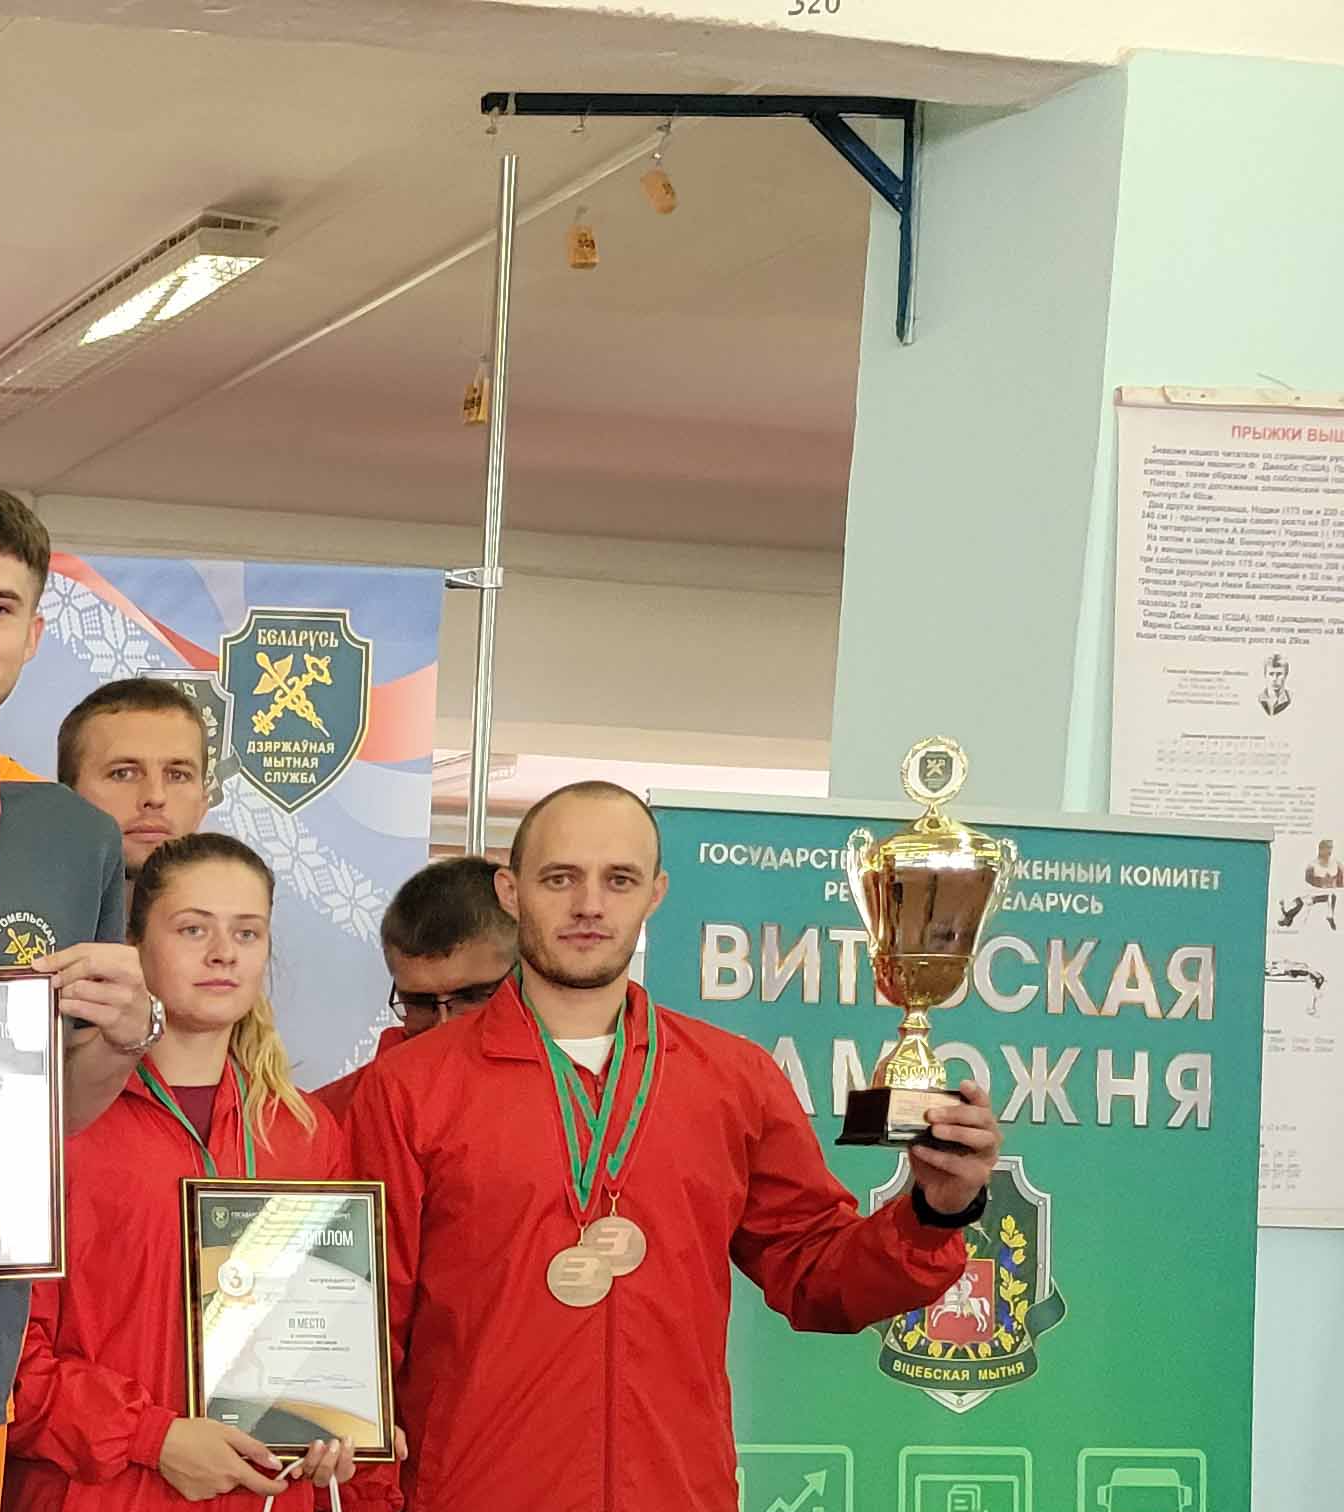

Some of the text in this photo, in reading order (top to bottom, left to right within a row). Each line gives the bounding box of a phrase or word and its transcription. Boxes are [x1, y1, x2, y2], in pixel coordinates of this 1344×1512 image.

[1232, 425, 1302, 440] ПРЫЖКИ
[247, 739, 334, 754] ДЗЯРЖАЎНАЯ
[263, 757, 319, 769] МЫТНАЯ
[264, 772, 316, 785] СЛУЖБА
[1120, 865, 1221, 890] КОМИТЕТ
[1002, 891, 1104, 915] ЕЛАРУСЬ
[701, 921, 1215, 1020] ВИТСКАЯ
[229, 1266, 243, 1289] 3
[297, 1318, 326, 1329] МЕСТО
